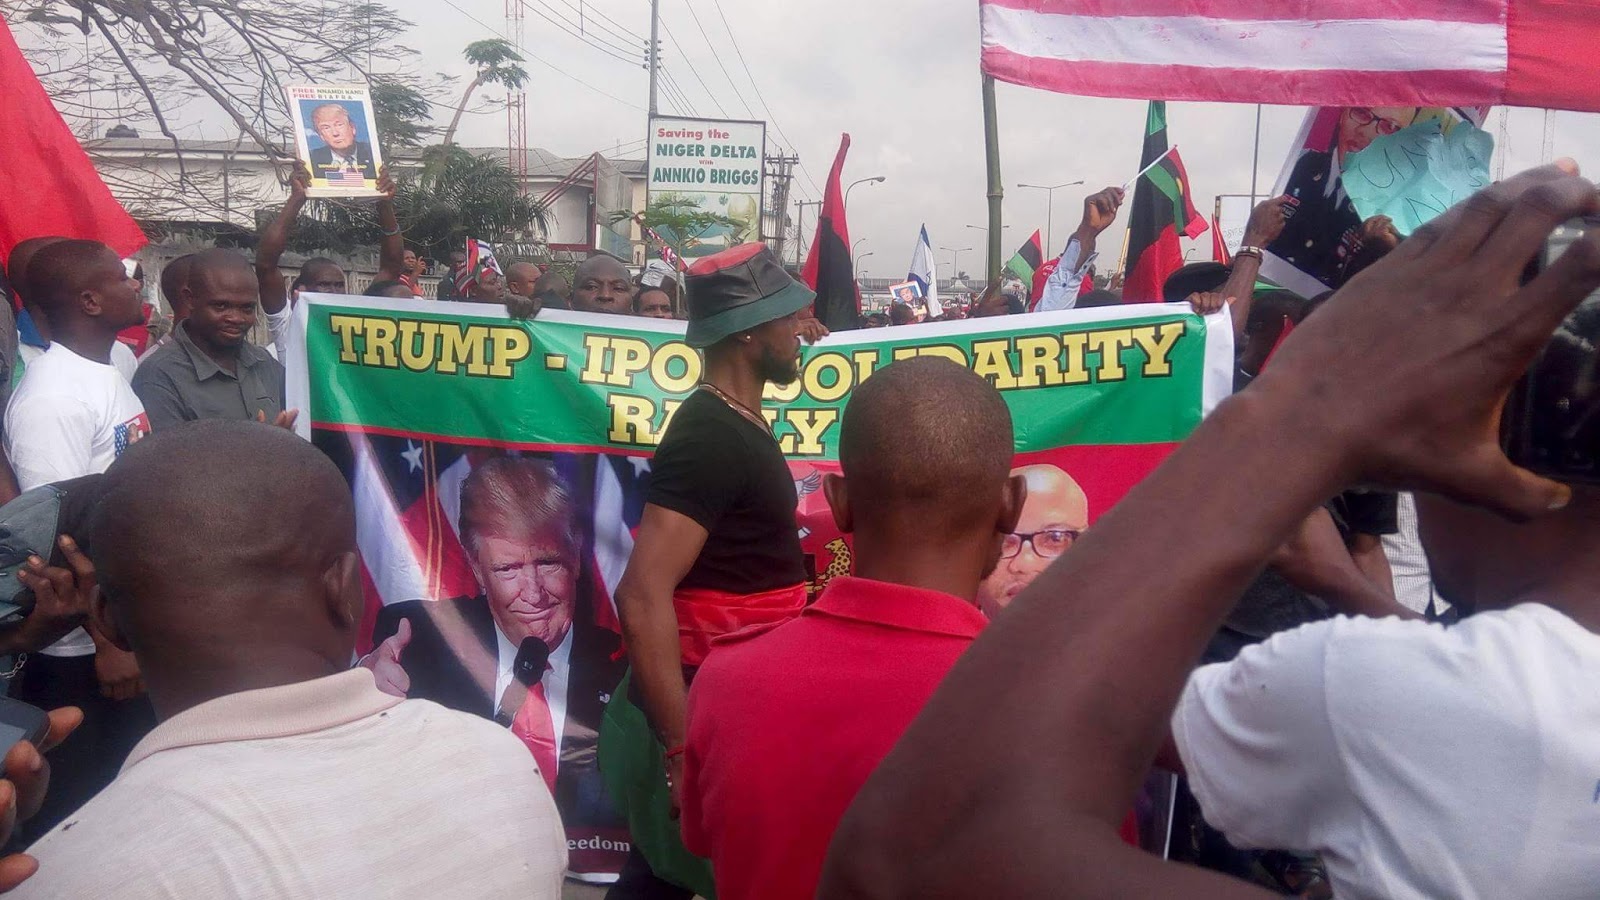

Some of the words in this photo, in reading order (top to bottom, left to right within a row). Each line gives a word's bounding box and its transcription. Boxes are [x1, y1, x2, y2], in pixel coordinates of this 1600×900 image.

[657, 128, 704, 140] Saving
[708, 129, 730, 140] the
[656, 143, 705, 157] NIGER
[710, 144, 757, 159] DELTA
[652, 167, 706, 184] ANNKIO
[710, 169, 759, 186] BRIGGS
[329, 313, 531, 380] TRUMP
[579, 332, 706, 394] IPO
[761, 320, 1187, 404] OARITY
[567, 835, 631, 852] eedom
